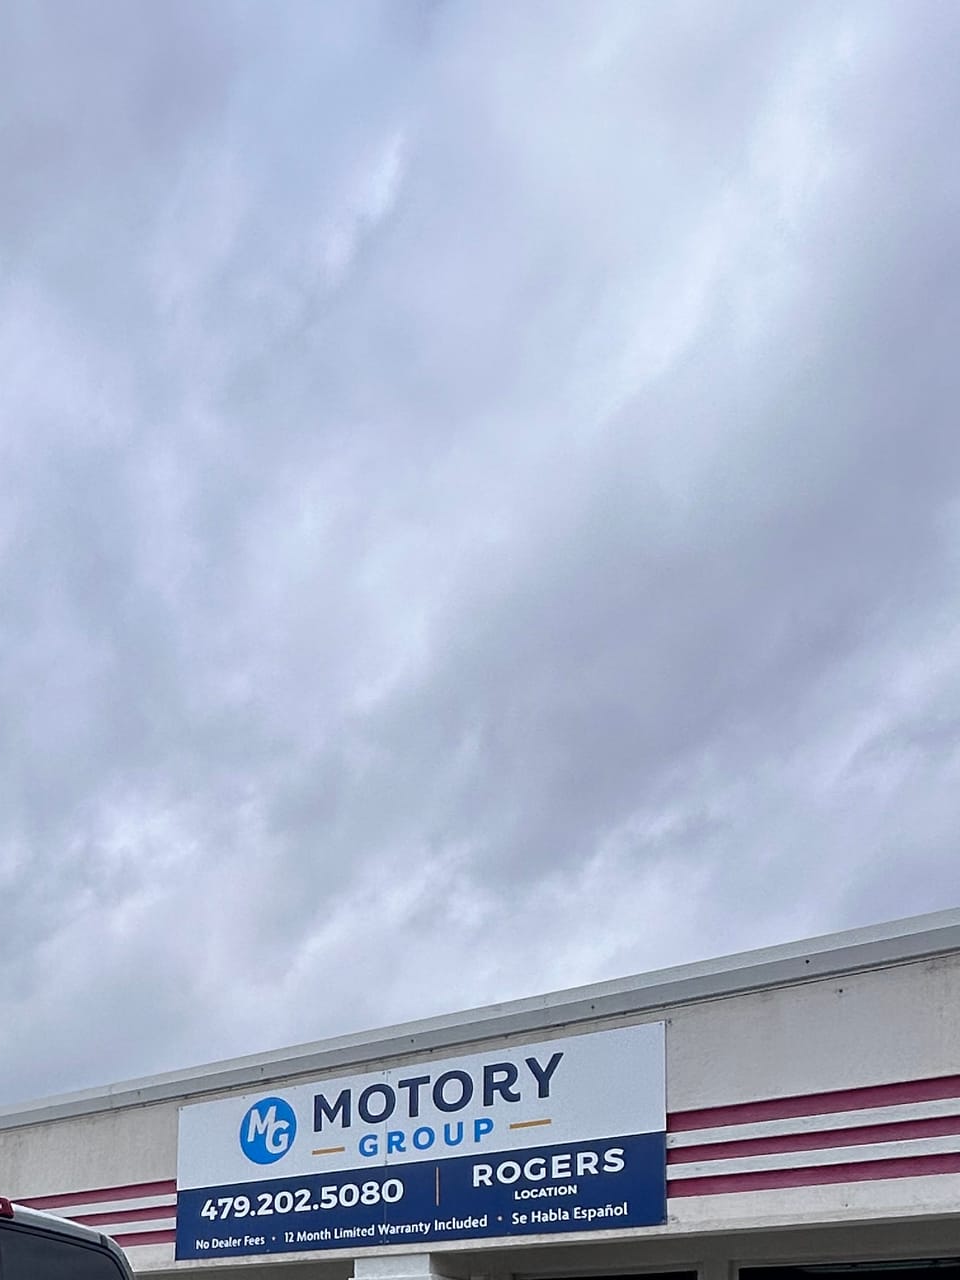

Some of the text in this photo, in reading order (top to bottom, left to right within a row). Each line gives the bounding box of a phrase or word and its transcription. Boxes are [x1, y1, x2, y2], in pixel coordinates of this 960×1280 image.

[312, 1052, 565, 1133] MOTORY
[246, 1105, 290, 1155] MG
[358, 1117, 495, 1158] GROUP
[472, 1147, 626, 1188] ROGERS
[200, 1178, 404, 1221] 479.202.5080
[514, 1184, 578, 1201] LOCATION
[195, 1202, 629, 1250] No Dealer Fees 12 Month Limited Warranty Included Se Habla Español
